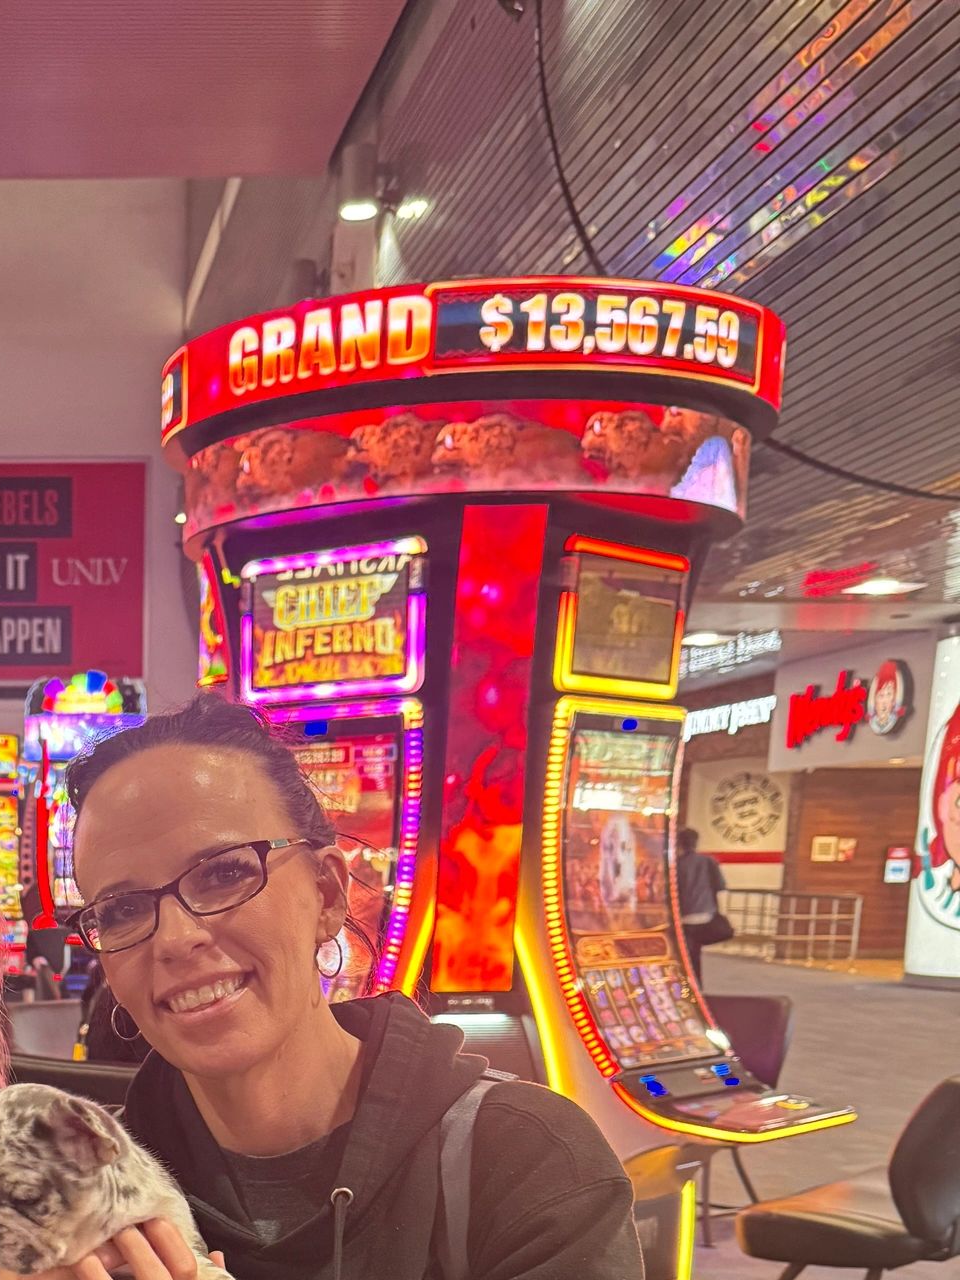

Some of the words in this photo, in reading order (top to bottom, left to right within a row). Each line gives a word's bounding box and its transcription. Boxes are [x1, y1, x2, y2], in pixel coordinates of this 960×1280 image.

[228, 295, 432, 395] GRAND
[479, 292, 740, 368] $13,567.59
[6, 553, 30, 591] IT
[51, 557, 129, 586] UNLV
[263, 617, 396, 667] INFERNO
